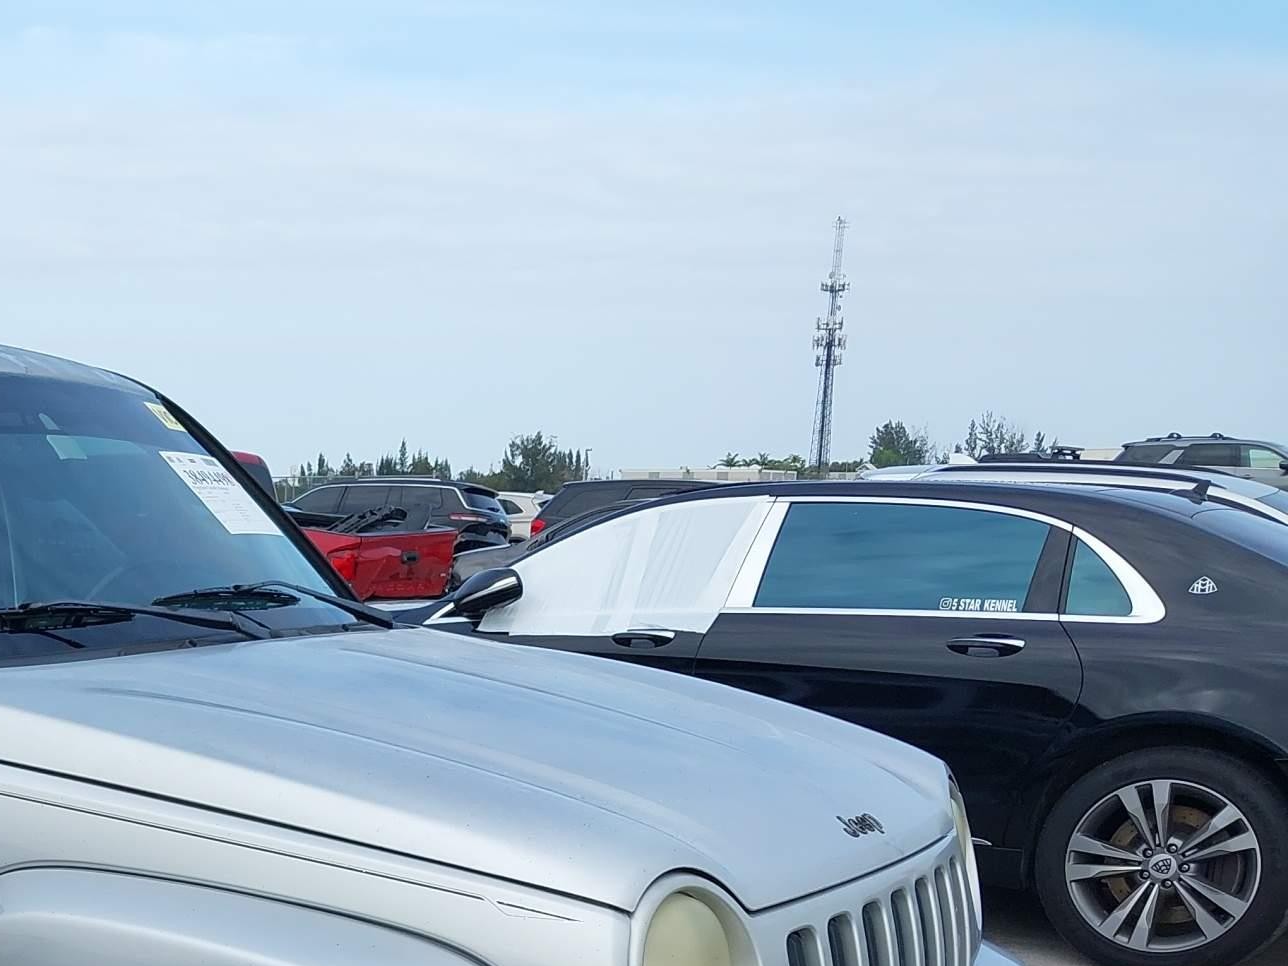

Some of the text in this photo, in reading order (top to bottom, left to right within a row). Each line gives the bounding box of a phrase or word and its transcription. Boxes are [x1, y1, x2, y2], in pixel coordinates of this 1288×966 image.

[951, 598, 1017, 611] 5 STAR KENNEL
[835, 813, 885, 838] Jeep
